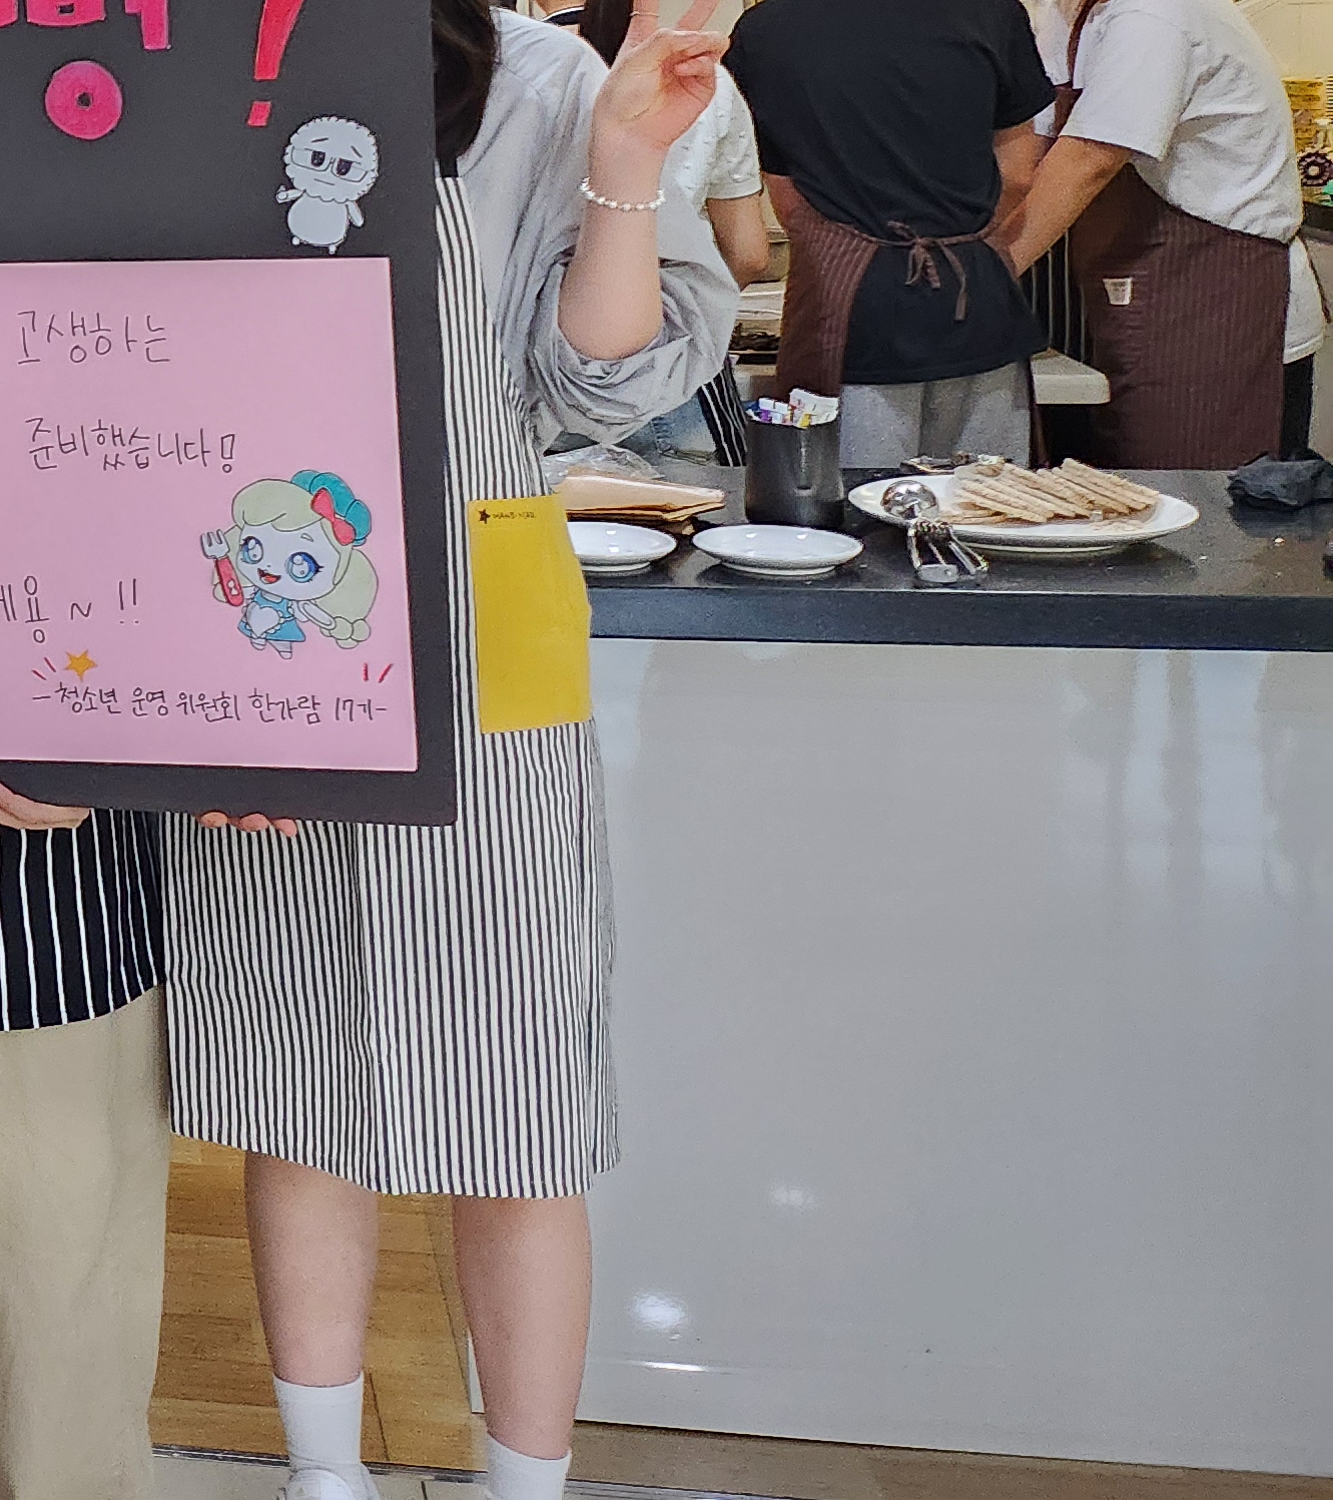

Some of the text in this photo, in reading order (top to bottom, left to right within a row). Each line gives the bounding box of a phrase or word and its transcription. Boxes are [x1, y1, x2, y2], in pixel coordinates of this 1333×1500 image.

[16, 310, 172, 366] 고생하는
[131, 686, 170, 717] 운영
[175, 690, 241, 723] 위원회
[247, 687, 322, 726] 한가람
